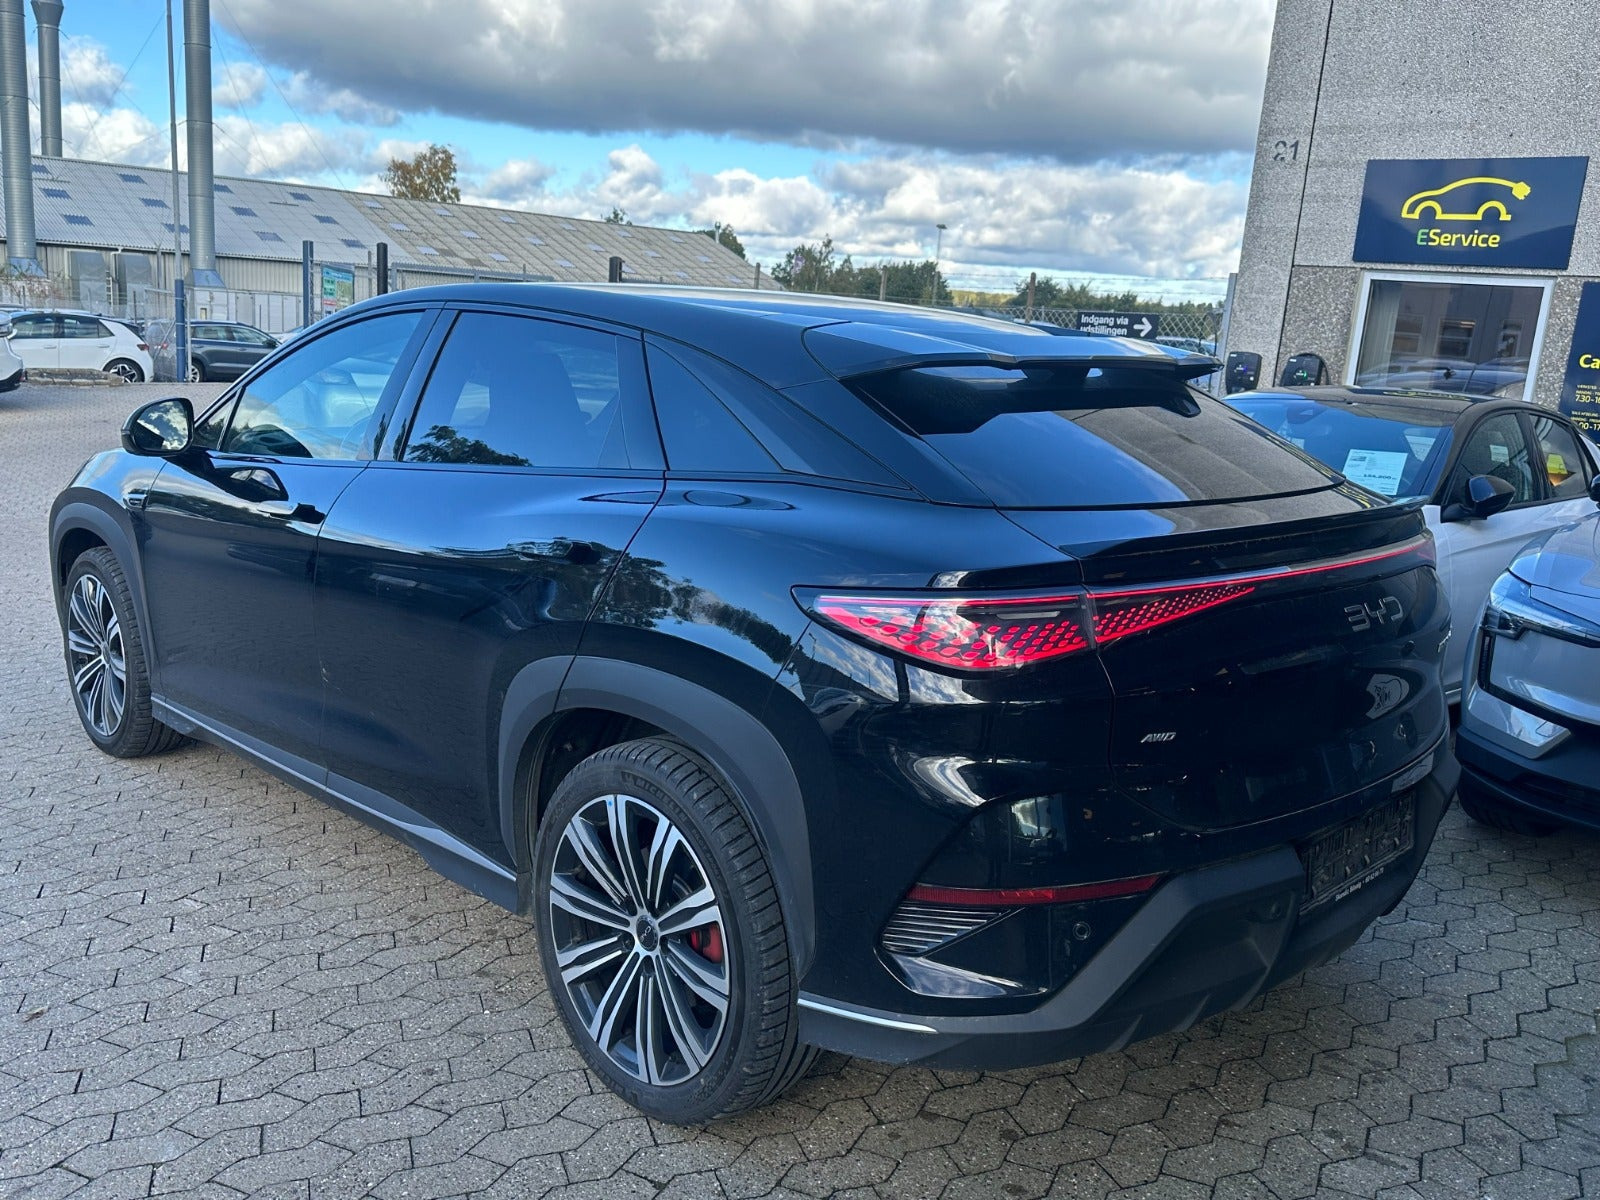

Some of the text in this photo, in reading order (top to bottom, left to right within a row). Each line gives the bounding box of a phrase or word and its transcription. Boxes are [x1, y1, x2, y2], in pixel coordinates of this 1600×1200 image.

[1273, 140, 1299, 160] 21
[1416, 228, 1501, 247] EService
[1081, 314, 1129, 326] Indgang via
[1080, 325, 1128, 336] udstillingen
[1344, 596, 1404, 632] BYD
[1140, 731, 1177, 743] AWD
